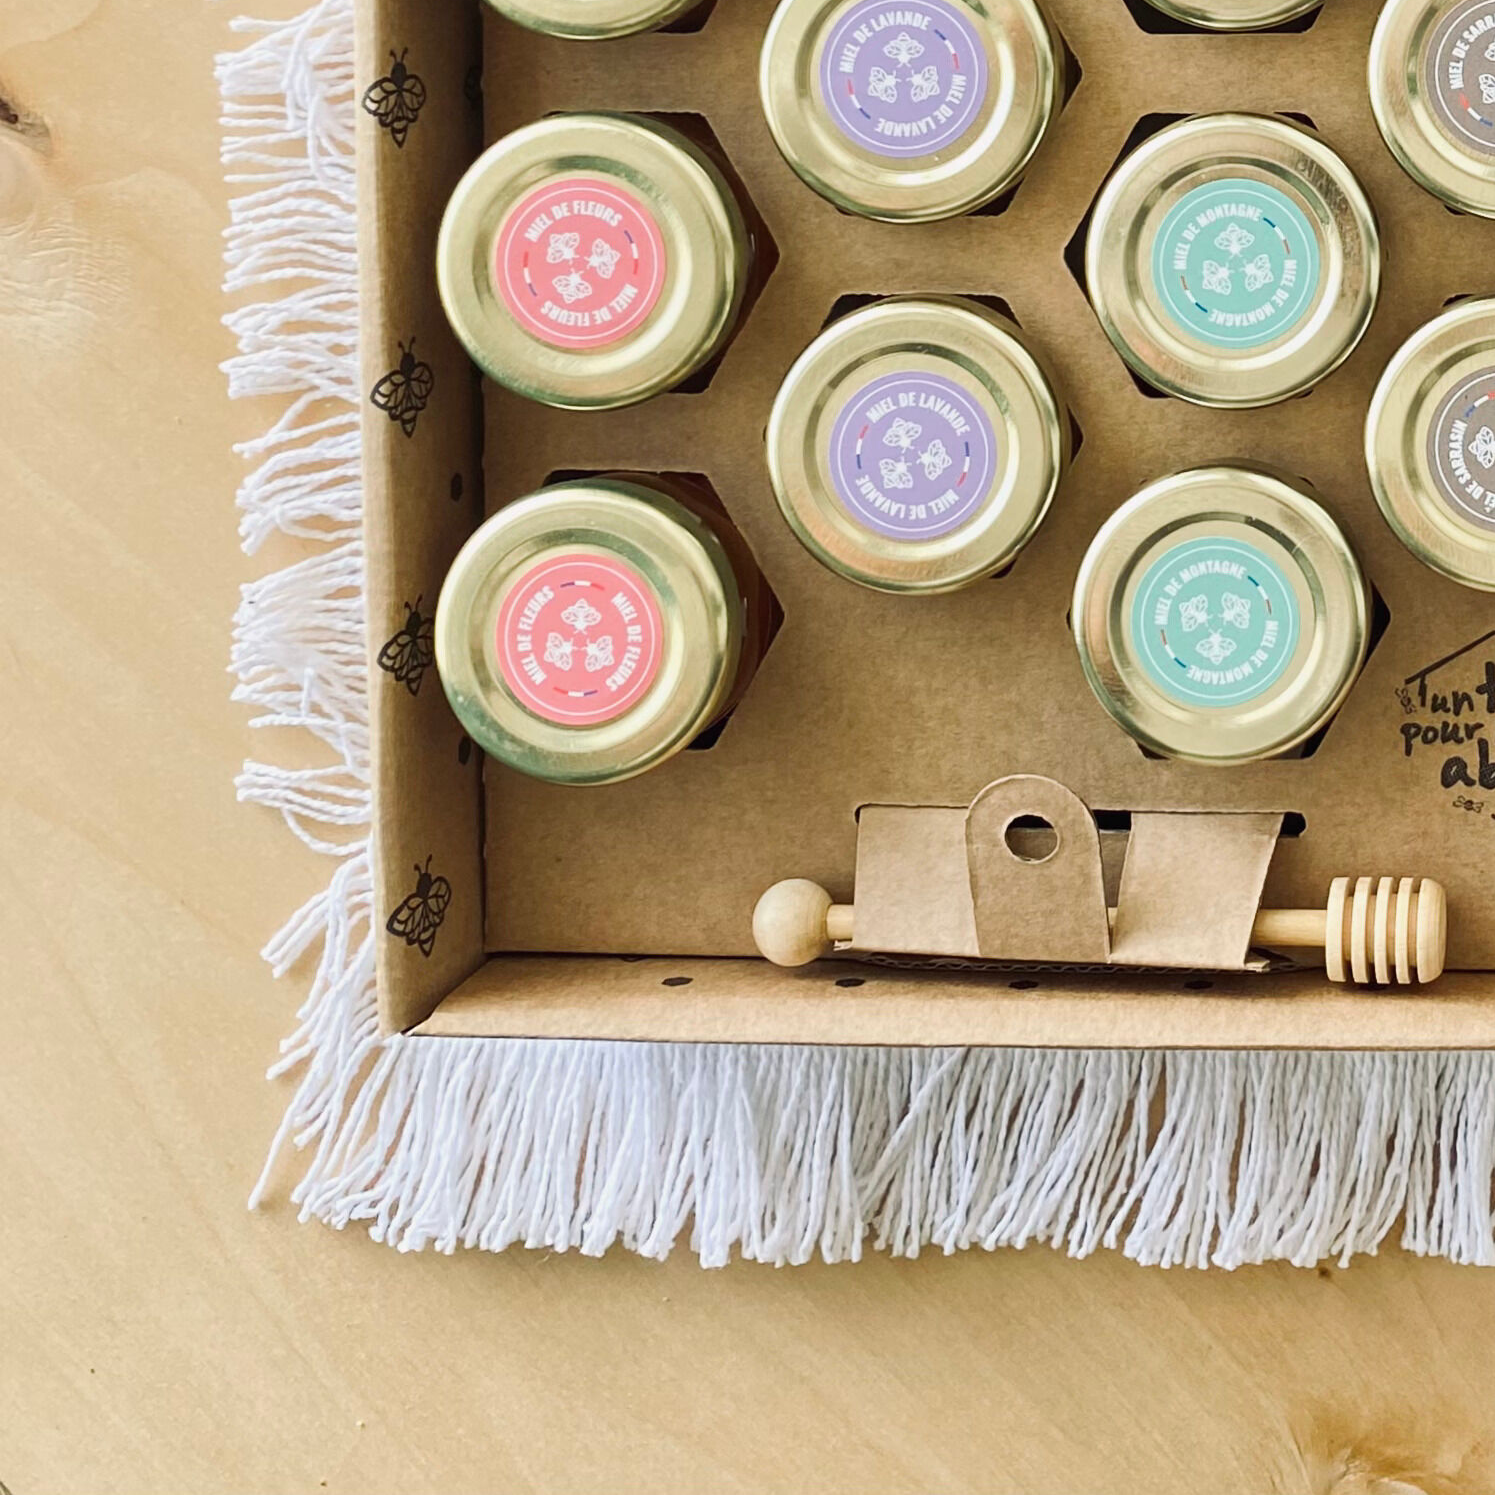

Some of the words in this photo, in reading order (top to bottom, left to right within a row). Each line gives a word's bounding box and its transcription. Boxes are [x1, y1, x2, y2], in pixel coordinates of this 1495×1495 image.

[840, 43, 860, 73] MIEL
[853, 24, 873, 43] DE
[870, 11, 932, 31] LAVANDE
[1452, 40, 1469, 58] DE
[1449, 61, 1464, 89] MIEL
[946, 75, 966, 104] MIEL
[875, 117, 936, 137] LAVANDE
[933, 104, 953, 123] DE
[524, 213, 553, 242] MIEL
[551, 202, 571, 219] DE
[572, 201, 622, 227] FLEURS
[1174, 243, 1190, 269] MIEL
[1182, 223, 1200, 241] DE
[1196, 203, 1262, 227] MONTAGNE
[1280, 260, 1296, 287] MIEL
[609, 284, 638, 313] MIEL
[1271, 289, 1289, 307] DE
[540, 301, 590, 326] FLEURS
[592, 307, 612, 324] DE
[1208, 302, 1275, 327] MONTAGNE
[866, 397, 897, 423] MIEL
[898, 392, 916, 407] DE
[918, 393, 970, 436] LAVANDE
[1449, 420, 1471, 484] SARRASIN
[856, 475, 906, 518] LAVANDE
[928, 489, 959, 515] MIEL
[1466, 481, 1484, 499] DE
[909, 505, 926, 519] DE
[1155, 597, 1172, 625] MIEL
[1164, 577, 1182, 596] DE
[1180, 560, 1246, 583] MONTAGNE
[518, 586, 554, 631] FLEURS
[611, 592, 637, 623] MIEL
[517, 635, 532, 651] DE
[627, 625, 642, 642] DE
[1260, 621, 1278, 647] MIEL
[522, 653, 546, 685] MIEL
[606, 646, 640, 691] FLEURS
[1250, 649, 1268, 667] DE
[1186, 661, 1254, 685] MONTAGNE
[1400, 721, 1484, 756] pour
